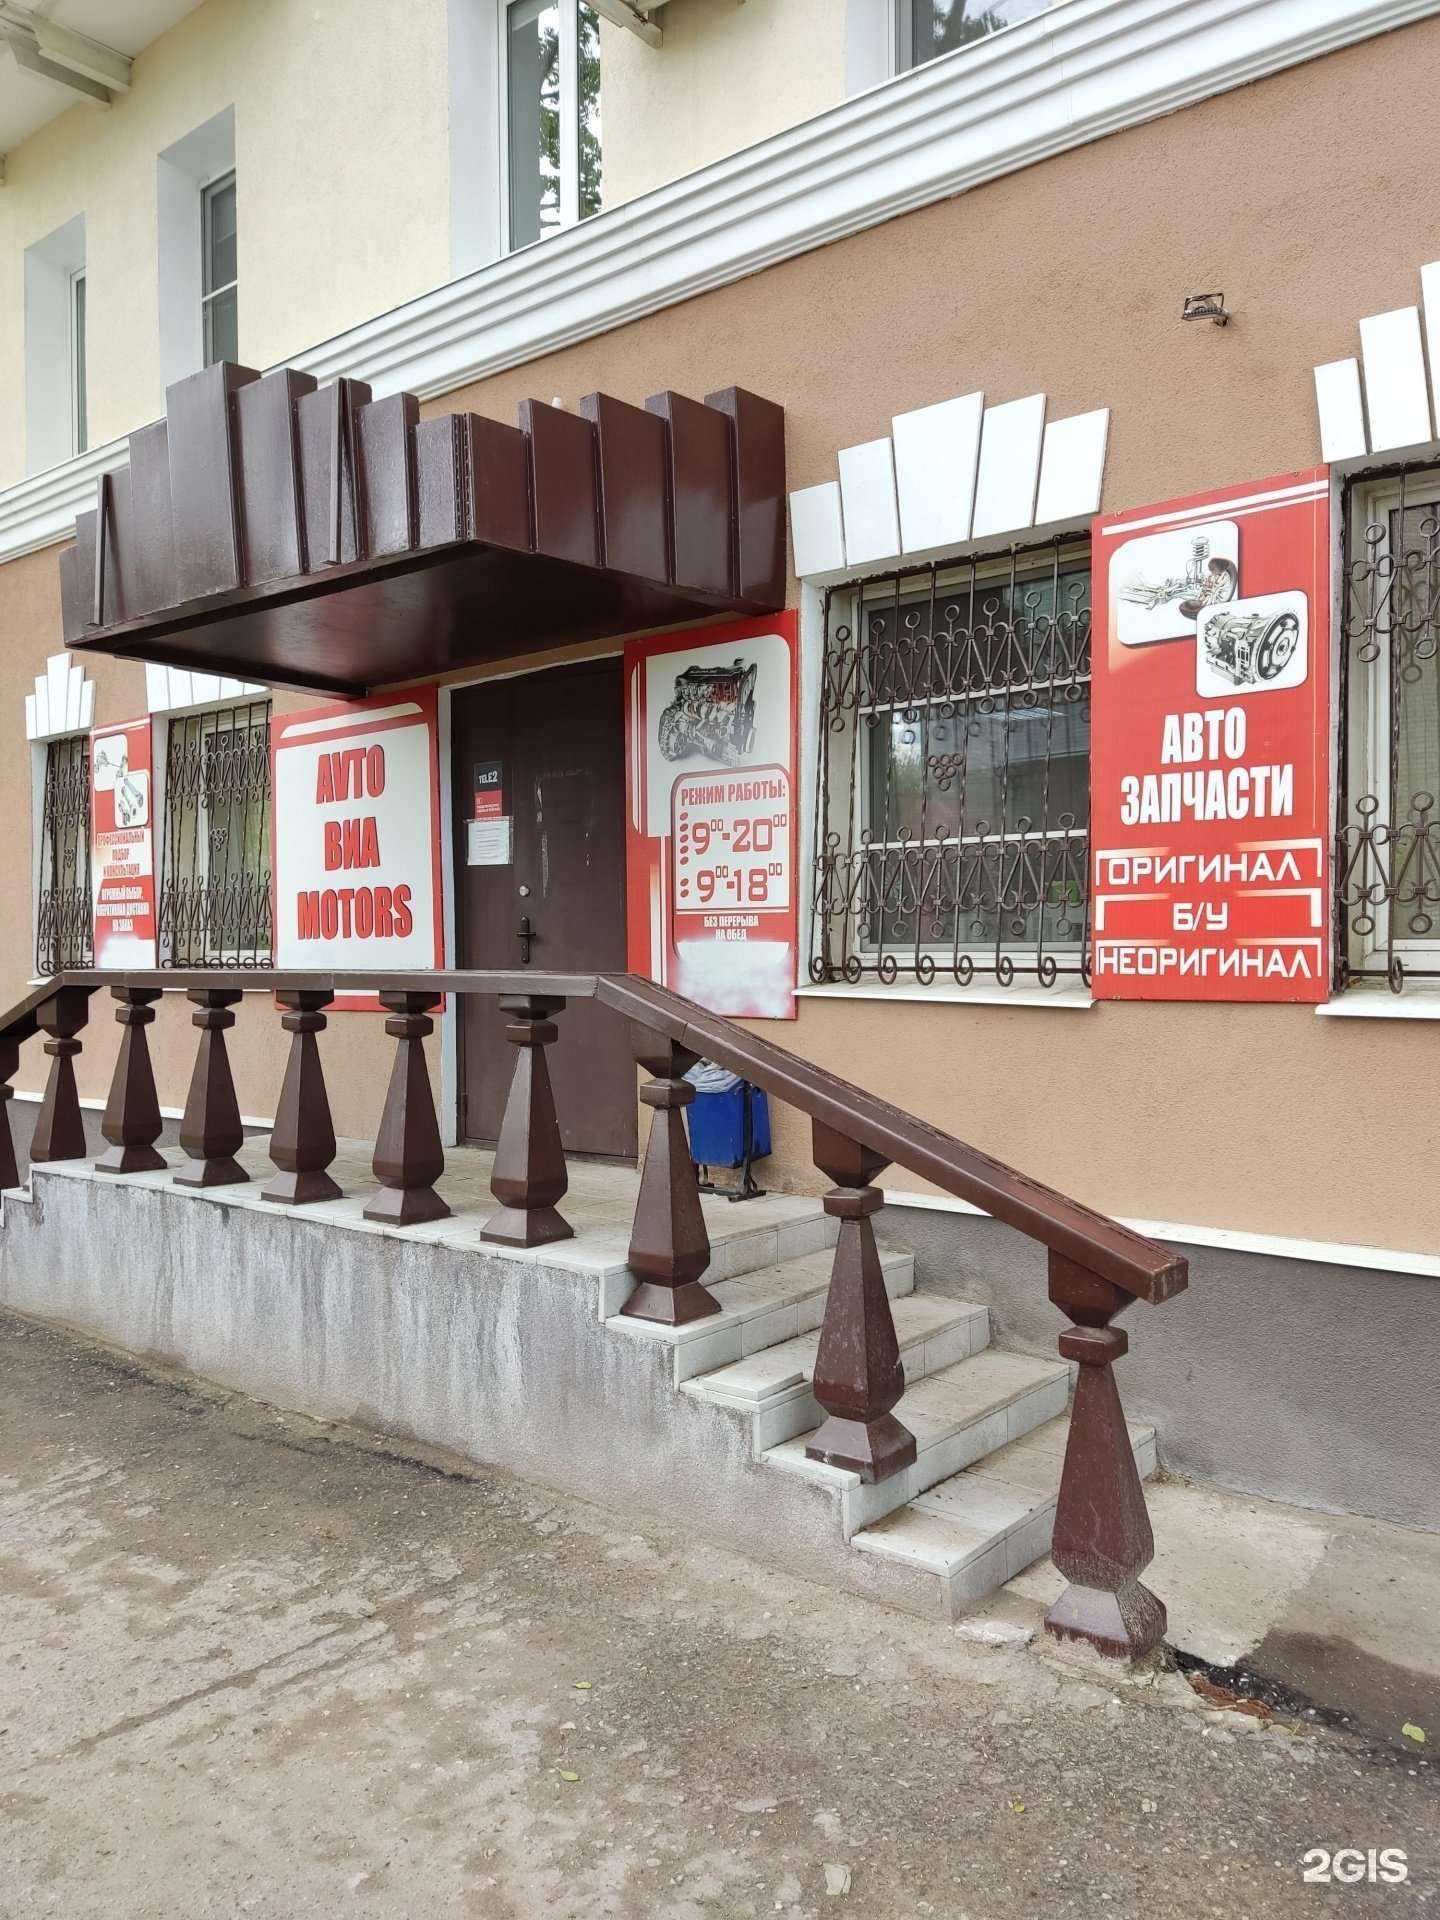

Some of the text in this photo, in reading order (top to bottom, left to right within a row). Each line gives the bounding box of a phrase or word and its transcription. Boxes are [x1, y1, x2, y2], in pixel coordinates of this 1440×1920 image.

[1160, 706, 1247, 765] АВТО
[315, 744, 386, 805] AVTO
[478, 771, 498, 785] TELE2
[681, 779, 786, 807] РЕЖИМ РАБОТЫ:
[1120, 764, 1294, 826] ЗАПЧАСТИ
[323, 816, 381, 872] ВИА
[1108, 850, 1301, 886] ОРИГИНАЛ
[297, 884, 413, 941] MOTORS
[704, 915, 759, 928] БЕЗ ПЕРЕРЫВА
[1172, 902, 1228, 931] Б/У
[715, 928, 747, 941] НА ОБЕД
[1098, 943, 1312, 979] НЕОРИГИНАЛ
